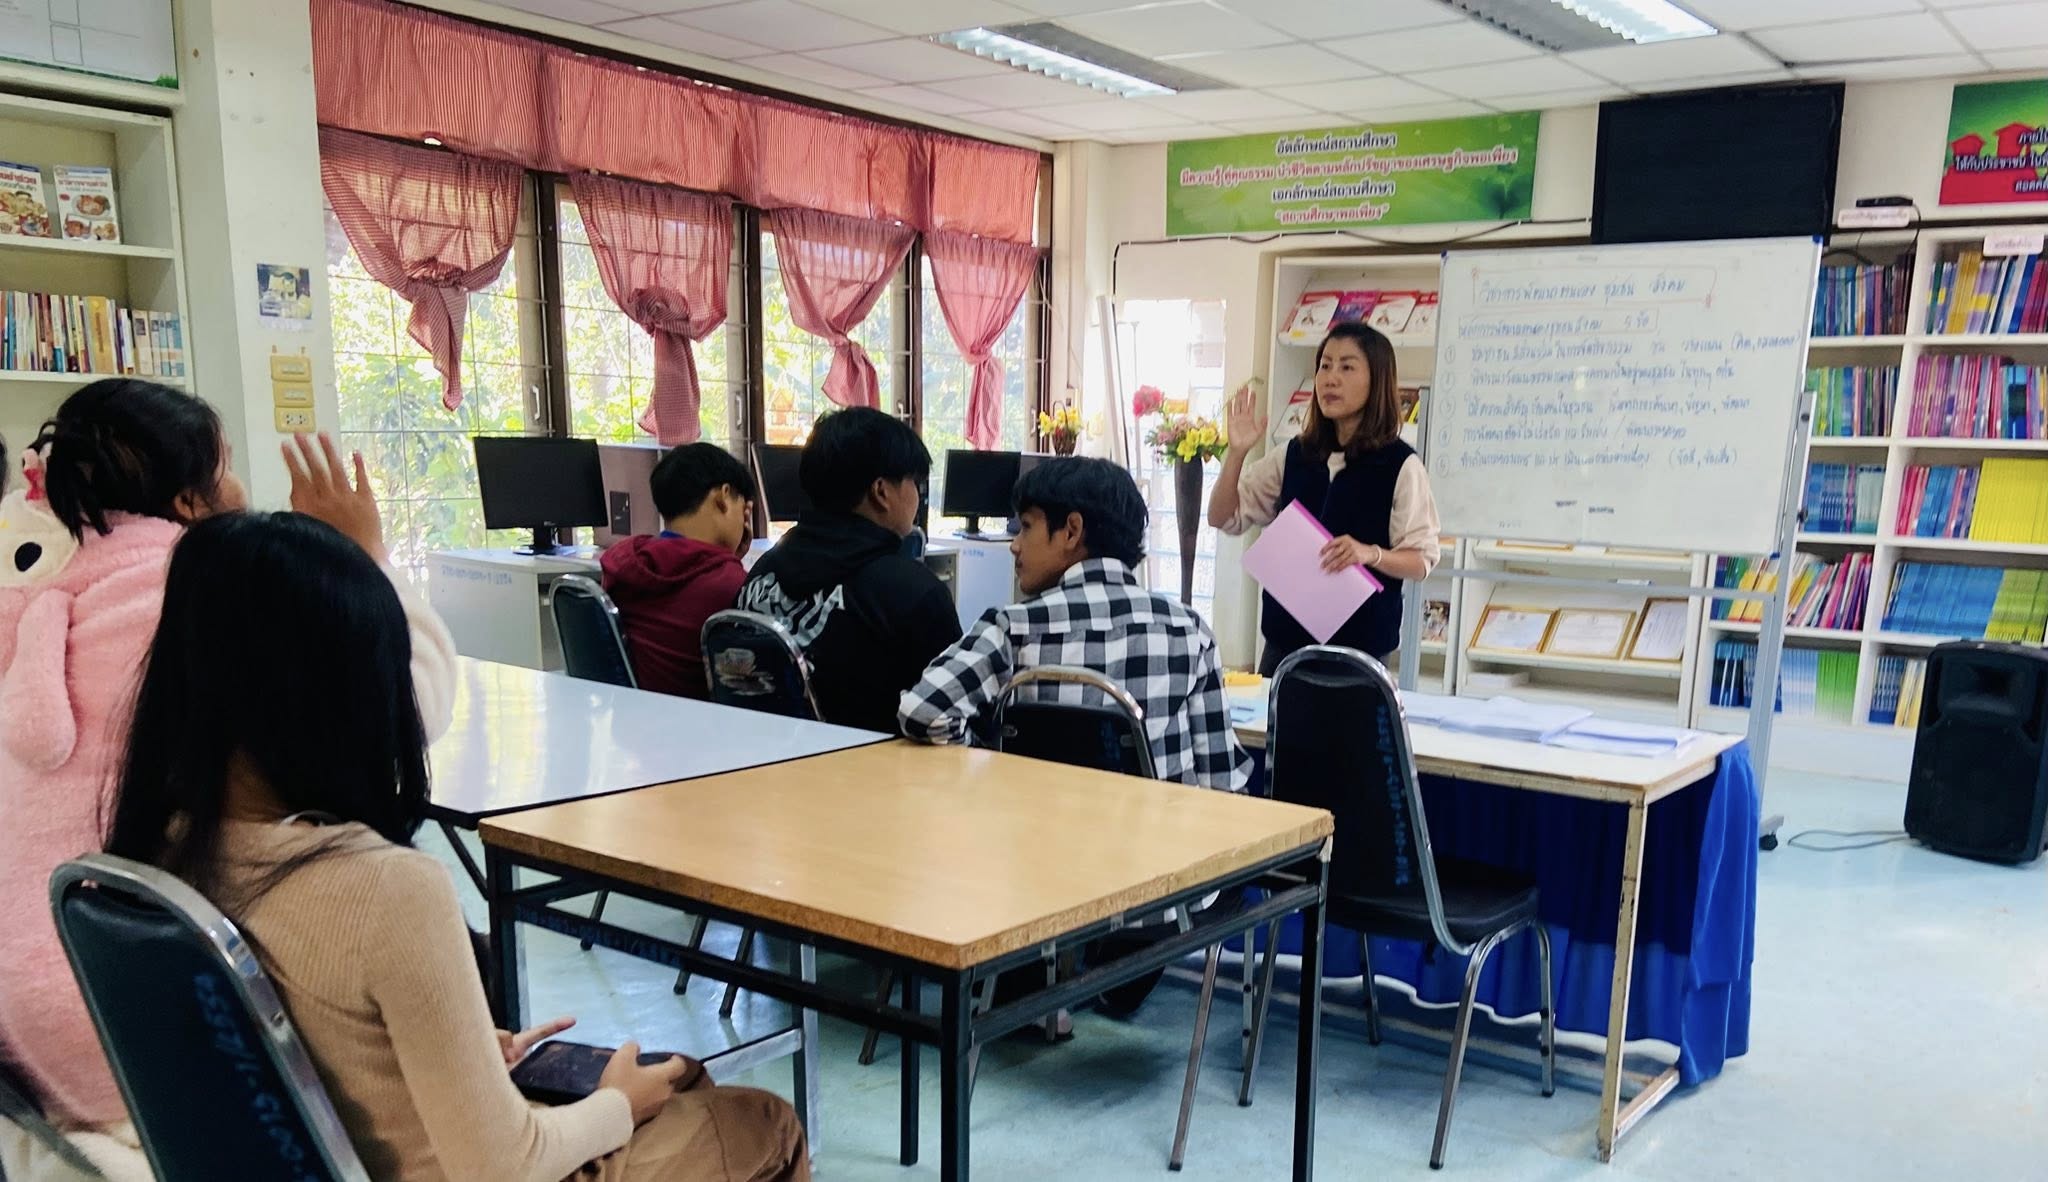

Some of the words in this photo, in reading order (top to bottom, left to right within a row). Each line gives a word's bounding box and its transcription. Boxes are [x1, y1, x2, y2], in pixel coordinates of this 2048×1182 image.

[1277, 130, 1396, 154] อัตลักษณ์สถานศึกษา
[1273, 178, 1395, 200] เอกลักษณ์สถานศึกษา
